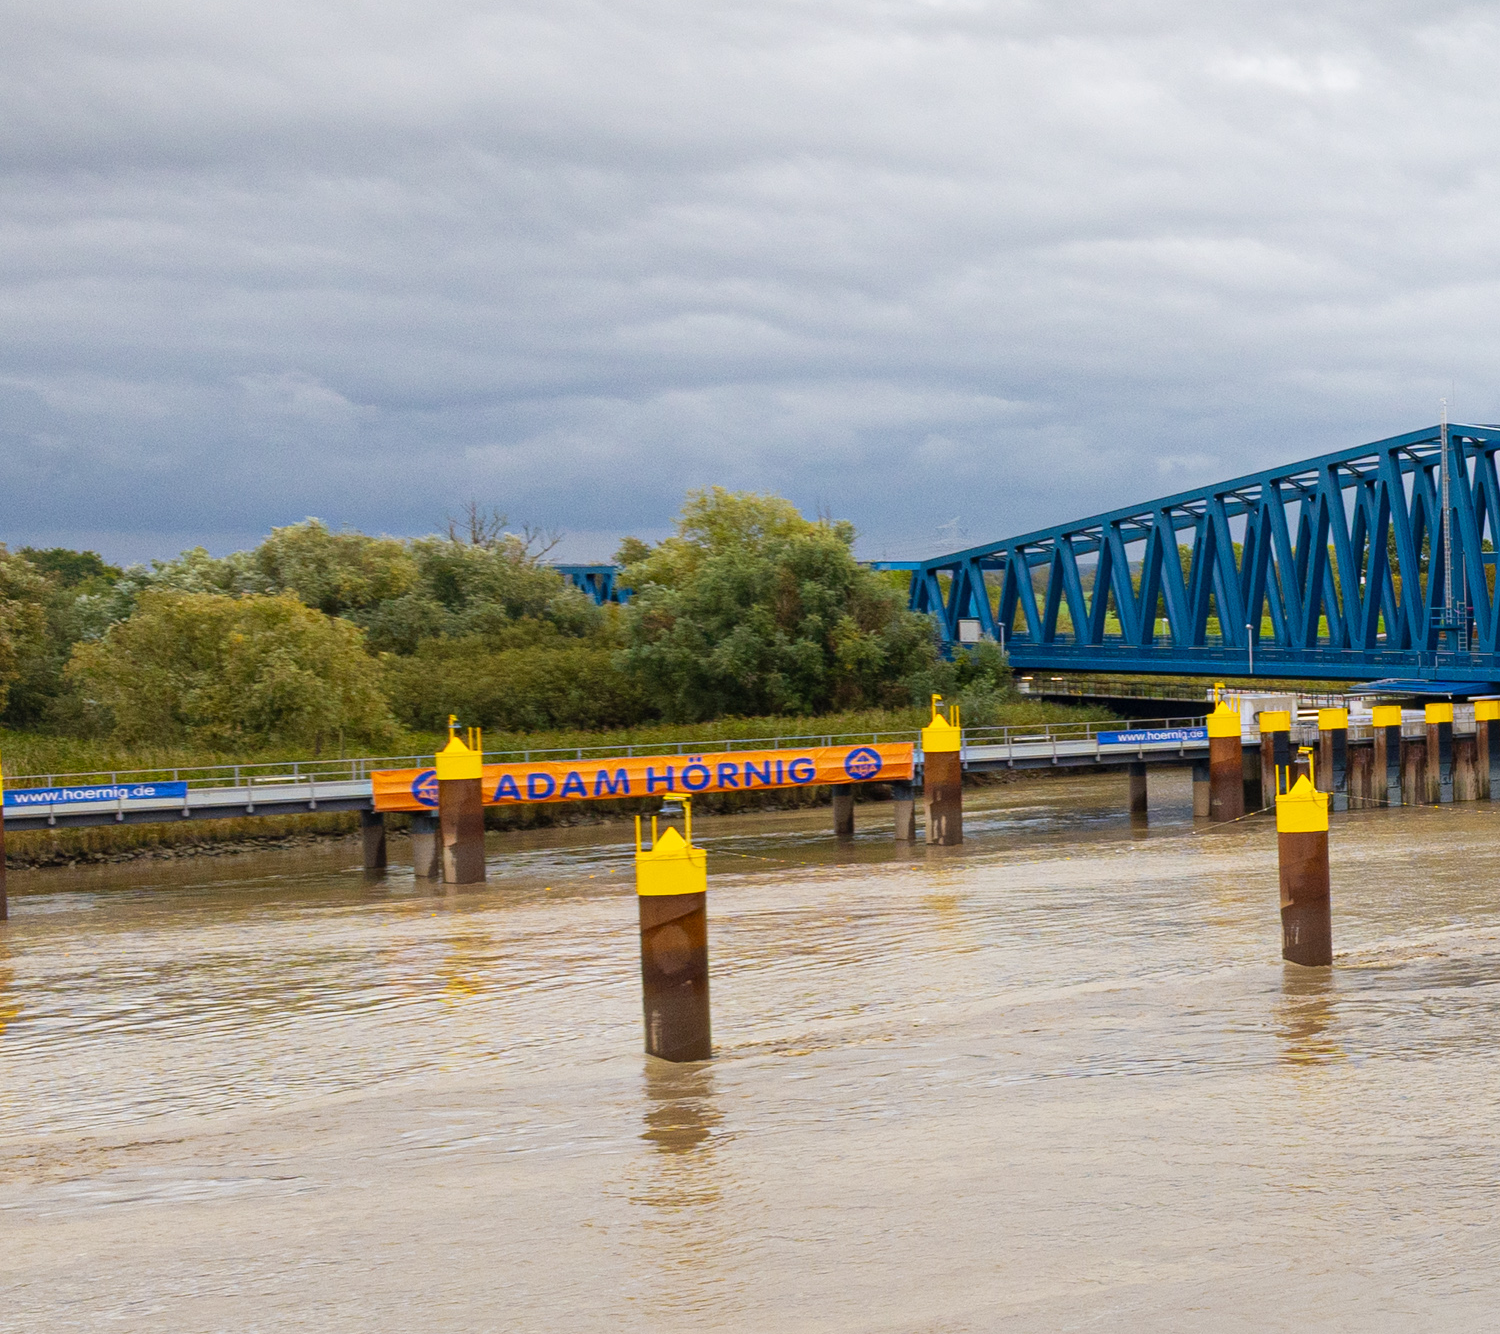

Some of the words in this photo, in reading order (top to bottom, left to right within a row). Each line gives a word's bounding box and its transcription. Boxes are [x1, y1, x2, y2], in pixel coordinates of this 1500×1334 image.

[492, 768, 631, 801] ADAM
[646, 756, 816, 793] HÖRNIG
[14, 786, 155, 803] www.hoernig.de
